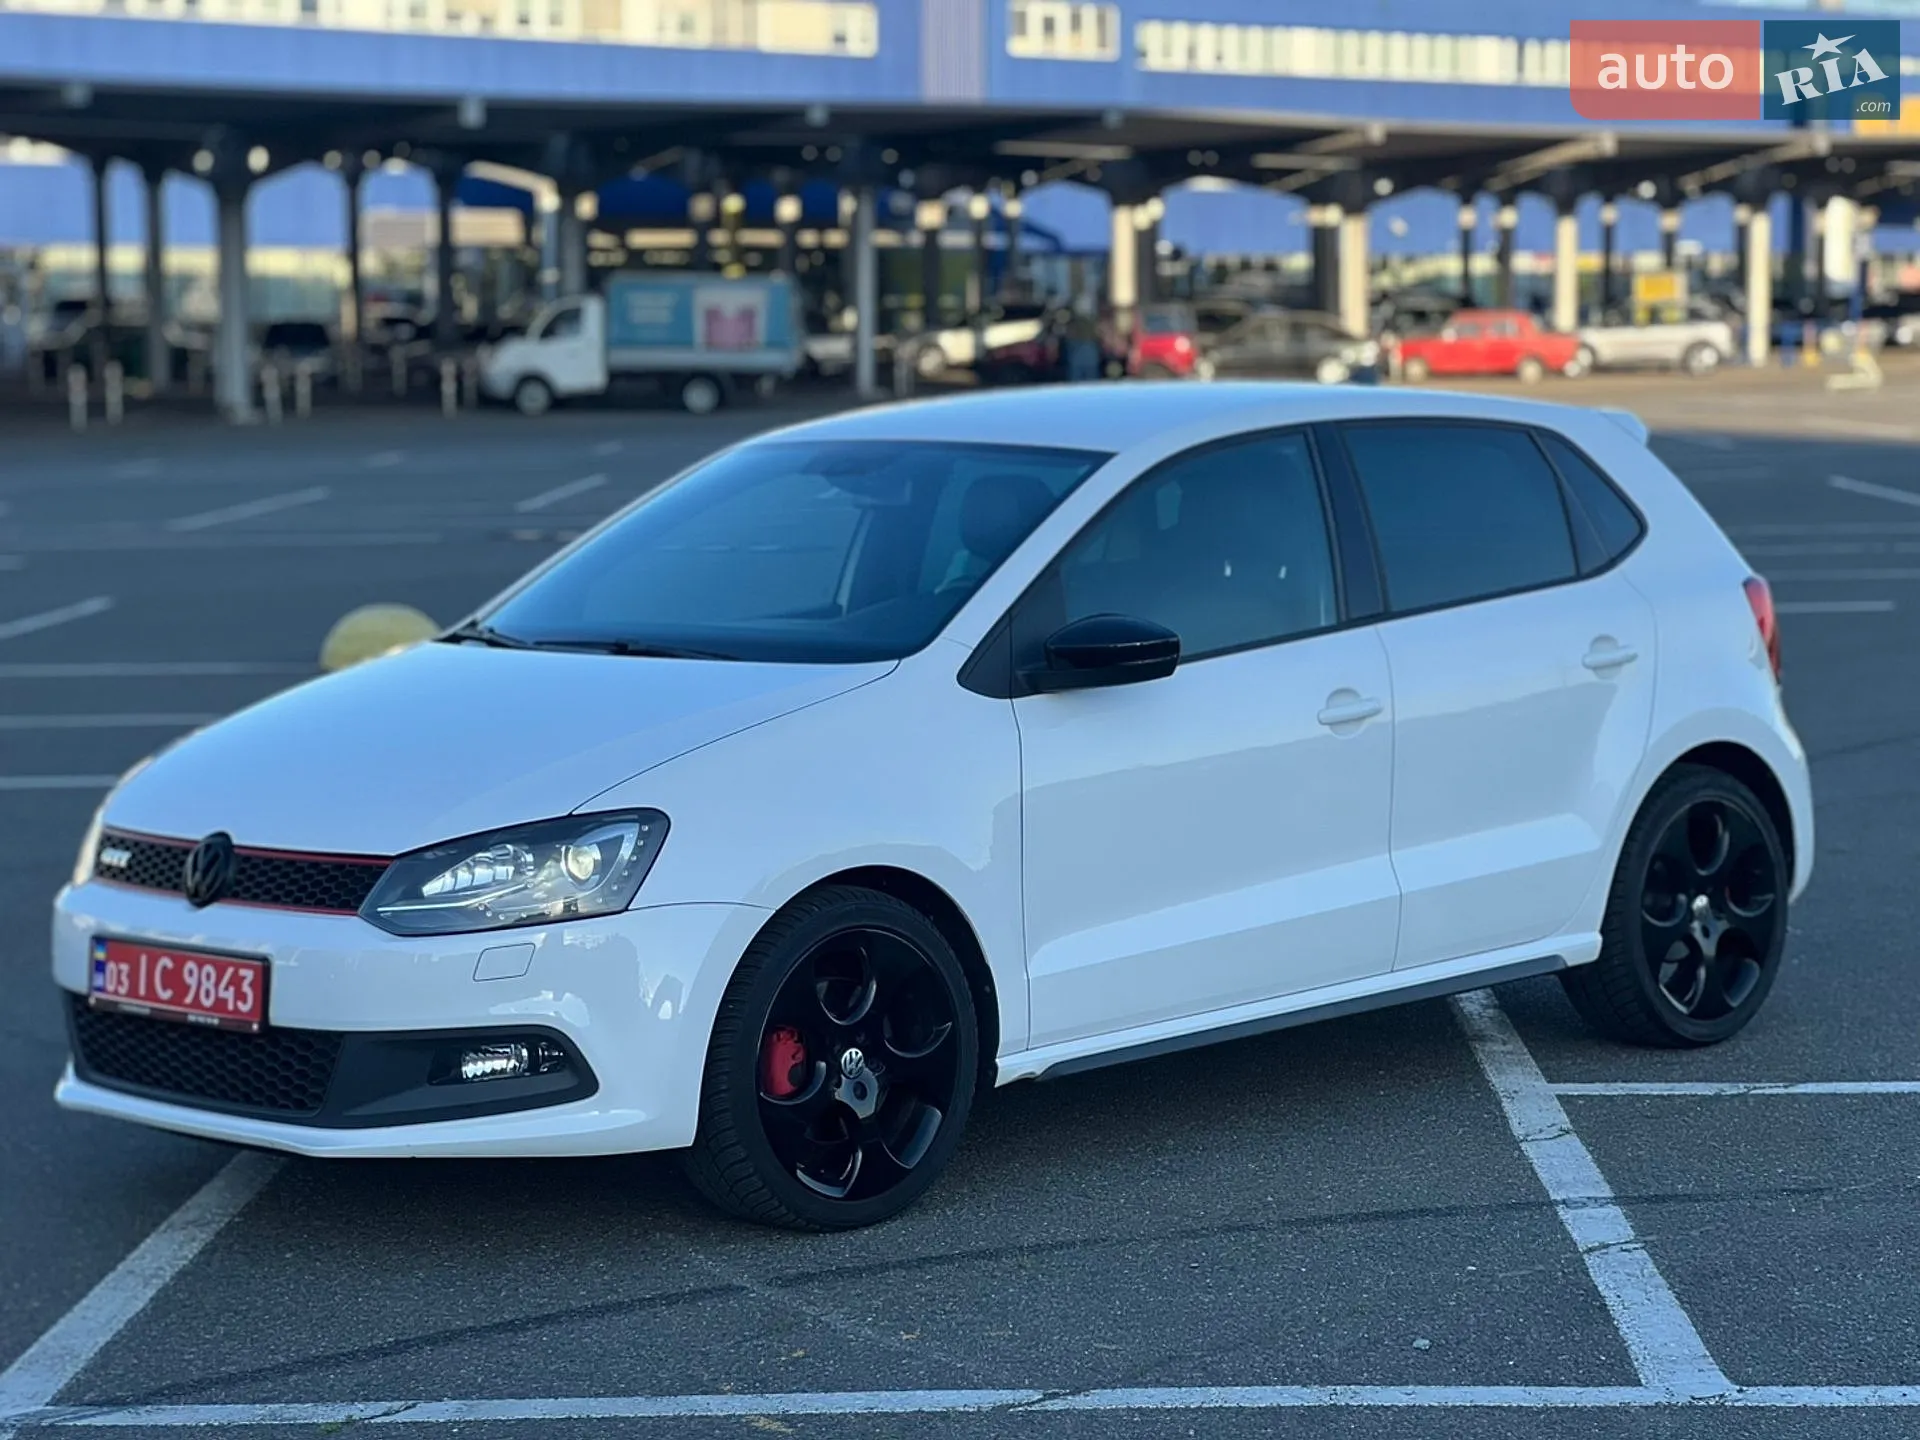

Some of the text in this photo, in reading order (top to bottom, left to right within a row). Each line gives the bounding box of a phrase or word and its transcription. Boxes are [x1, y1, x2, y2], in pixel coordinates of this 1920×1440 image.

[105, 960, 130, 996] 03
[138, 953, 175, 1000] IC
[183, 960, 255, 1013] 9843
